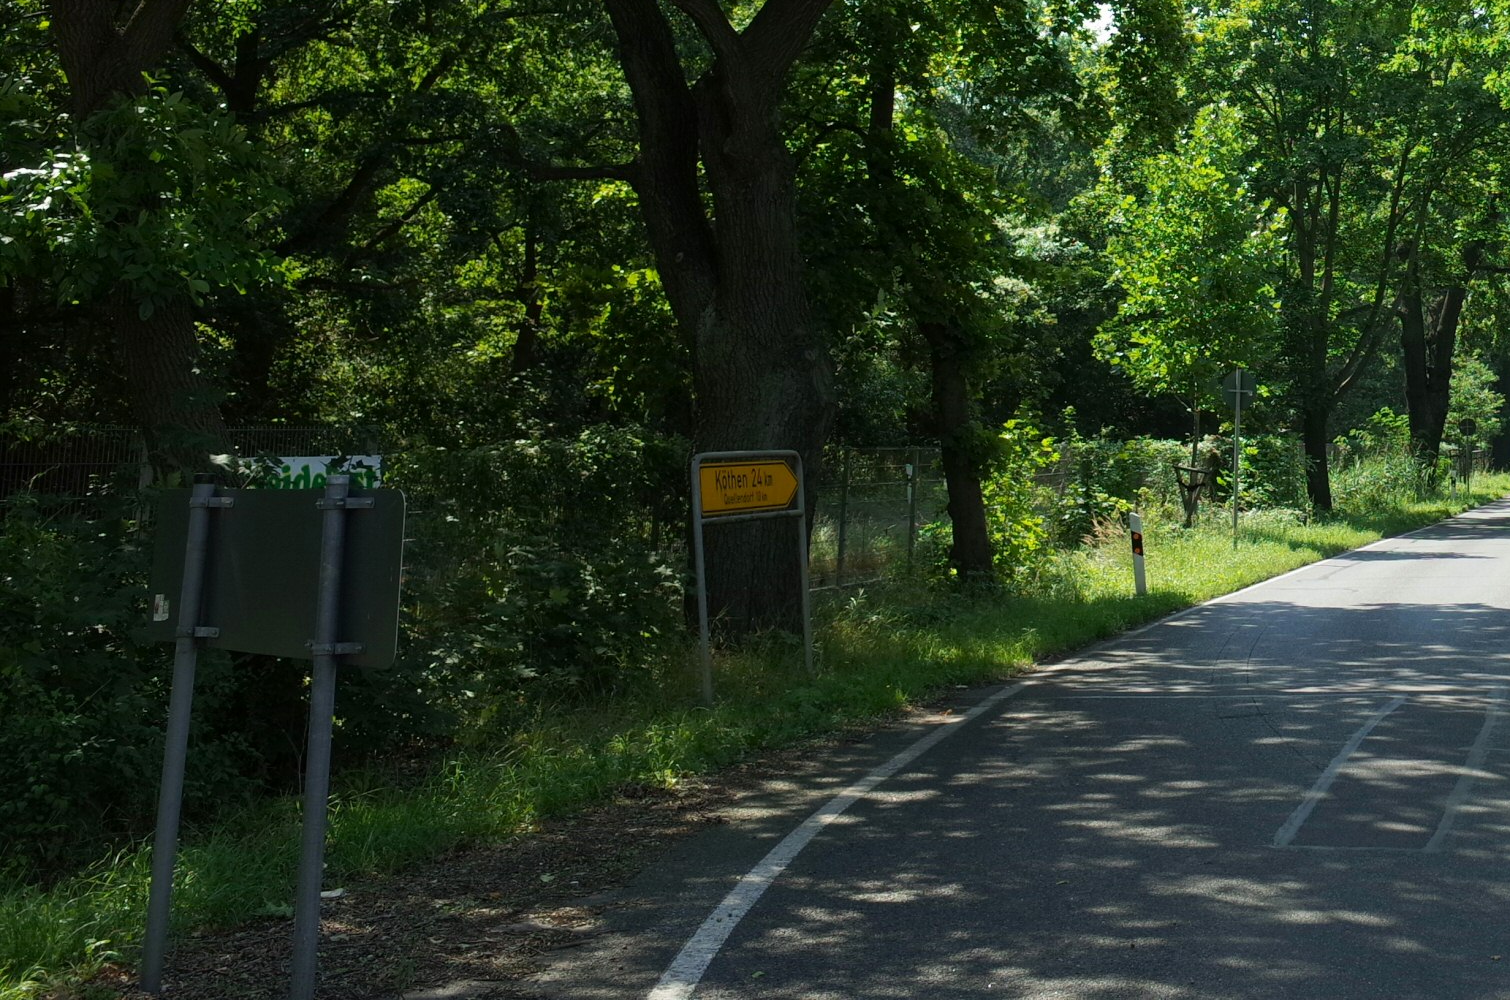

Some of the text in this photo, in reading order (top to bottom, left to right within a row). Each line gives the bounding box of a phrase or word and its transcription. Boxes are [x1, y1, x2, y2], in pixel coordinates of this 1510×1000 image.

[715, 467, 773, 491] Köthen 24 km
